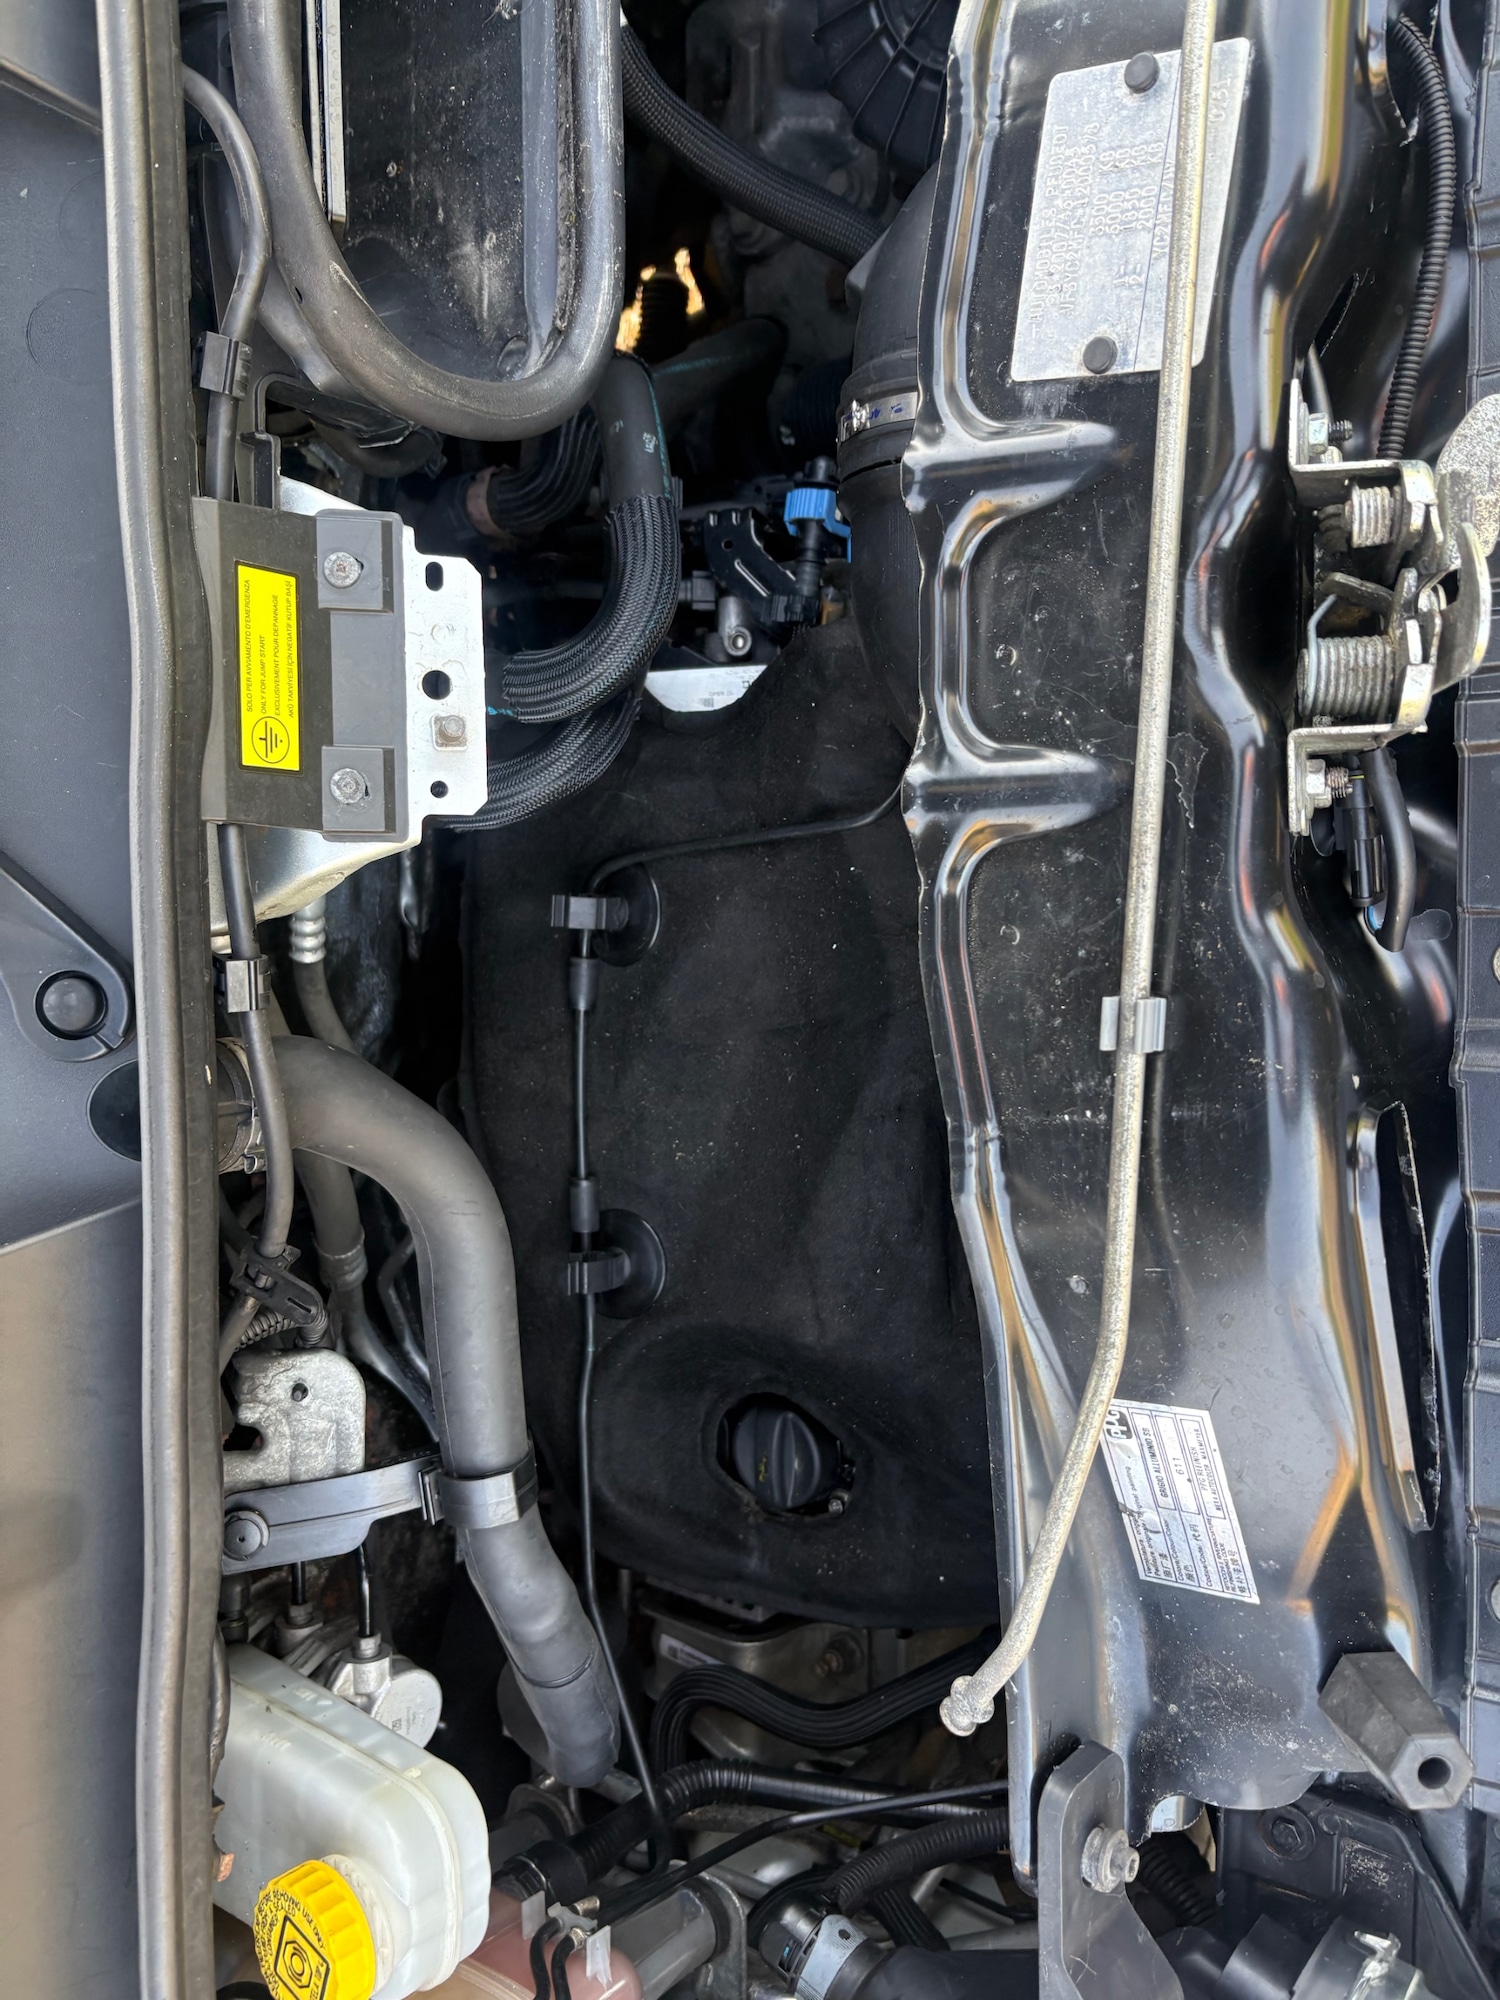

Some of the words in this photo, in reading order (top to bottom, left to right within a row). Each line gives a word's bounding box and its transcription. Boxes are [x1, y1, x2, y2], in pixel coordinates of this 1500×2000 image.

[1028, 208, 1058, 322] AUTOMOBILES
[1044, 124, 1069, 197] PEUGEOT
[1089, 193, 1109, 236] 3500
[1105, 189, 1125, 234] 6000
[1136, 184, 1157, 229] 2000
[243, 578, 251, 629] D'EMERGENZA
[244, 629, 252, 675] AVVIAMENTO
[1144, 1437, 1161, 1474] ALLUMINIO
[1171, 1456, 1185, 1475] 611
[1189, 1445, 1204, 1475] REFINISH
[1123, 1465, 1137, 1490] painting
[1155, 1474, 1168, 1498] GRIGIO
[1198, 1477, 1208, 1490] PPG
[1203, 1463, 1217, 1495] AUTOCOLOR
[258, 1892, 273, 1915] BEFORE
[273, 1890, 301, 1911] REMOVING
[302, 1907, 314, 1927] USE
[313, 1925, 325, 1949] ONLY
[273, 1900, 296, 1917] SEALED
